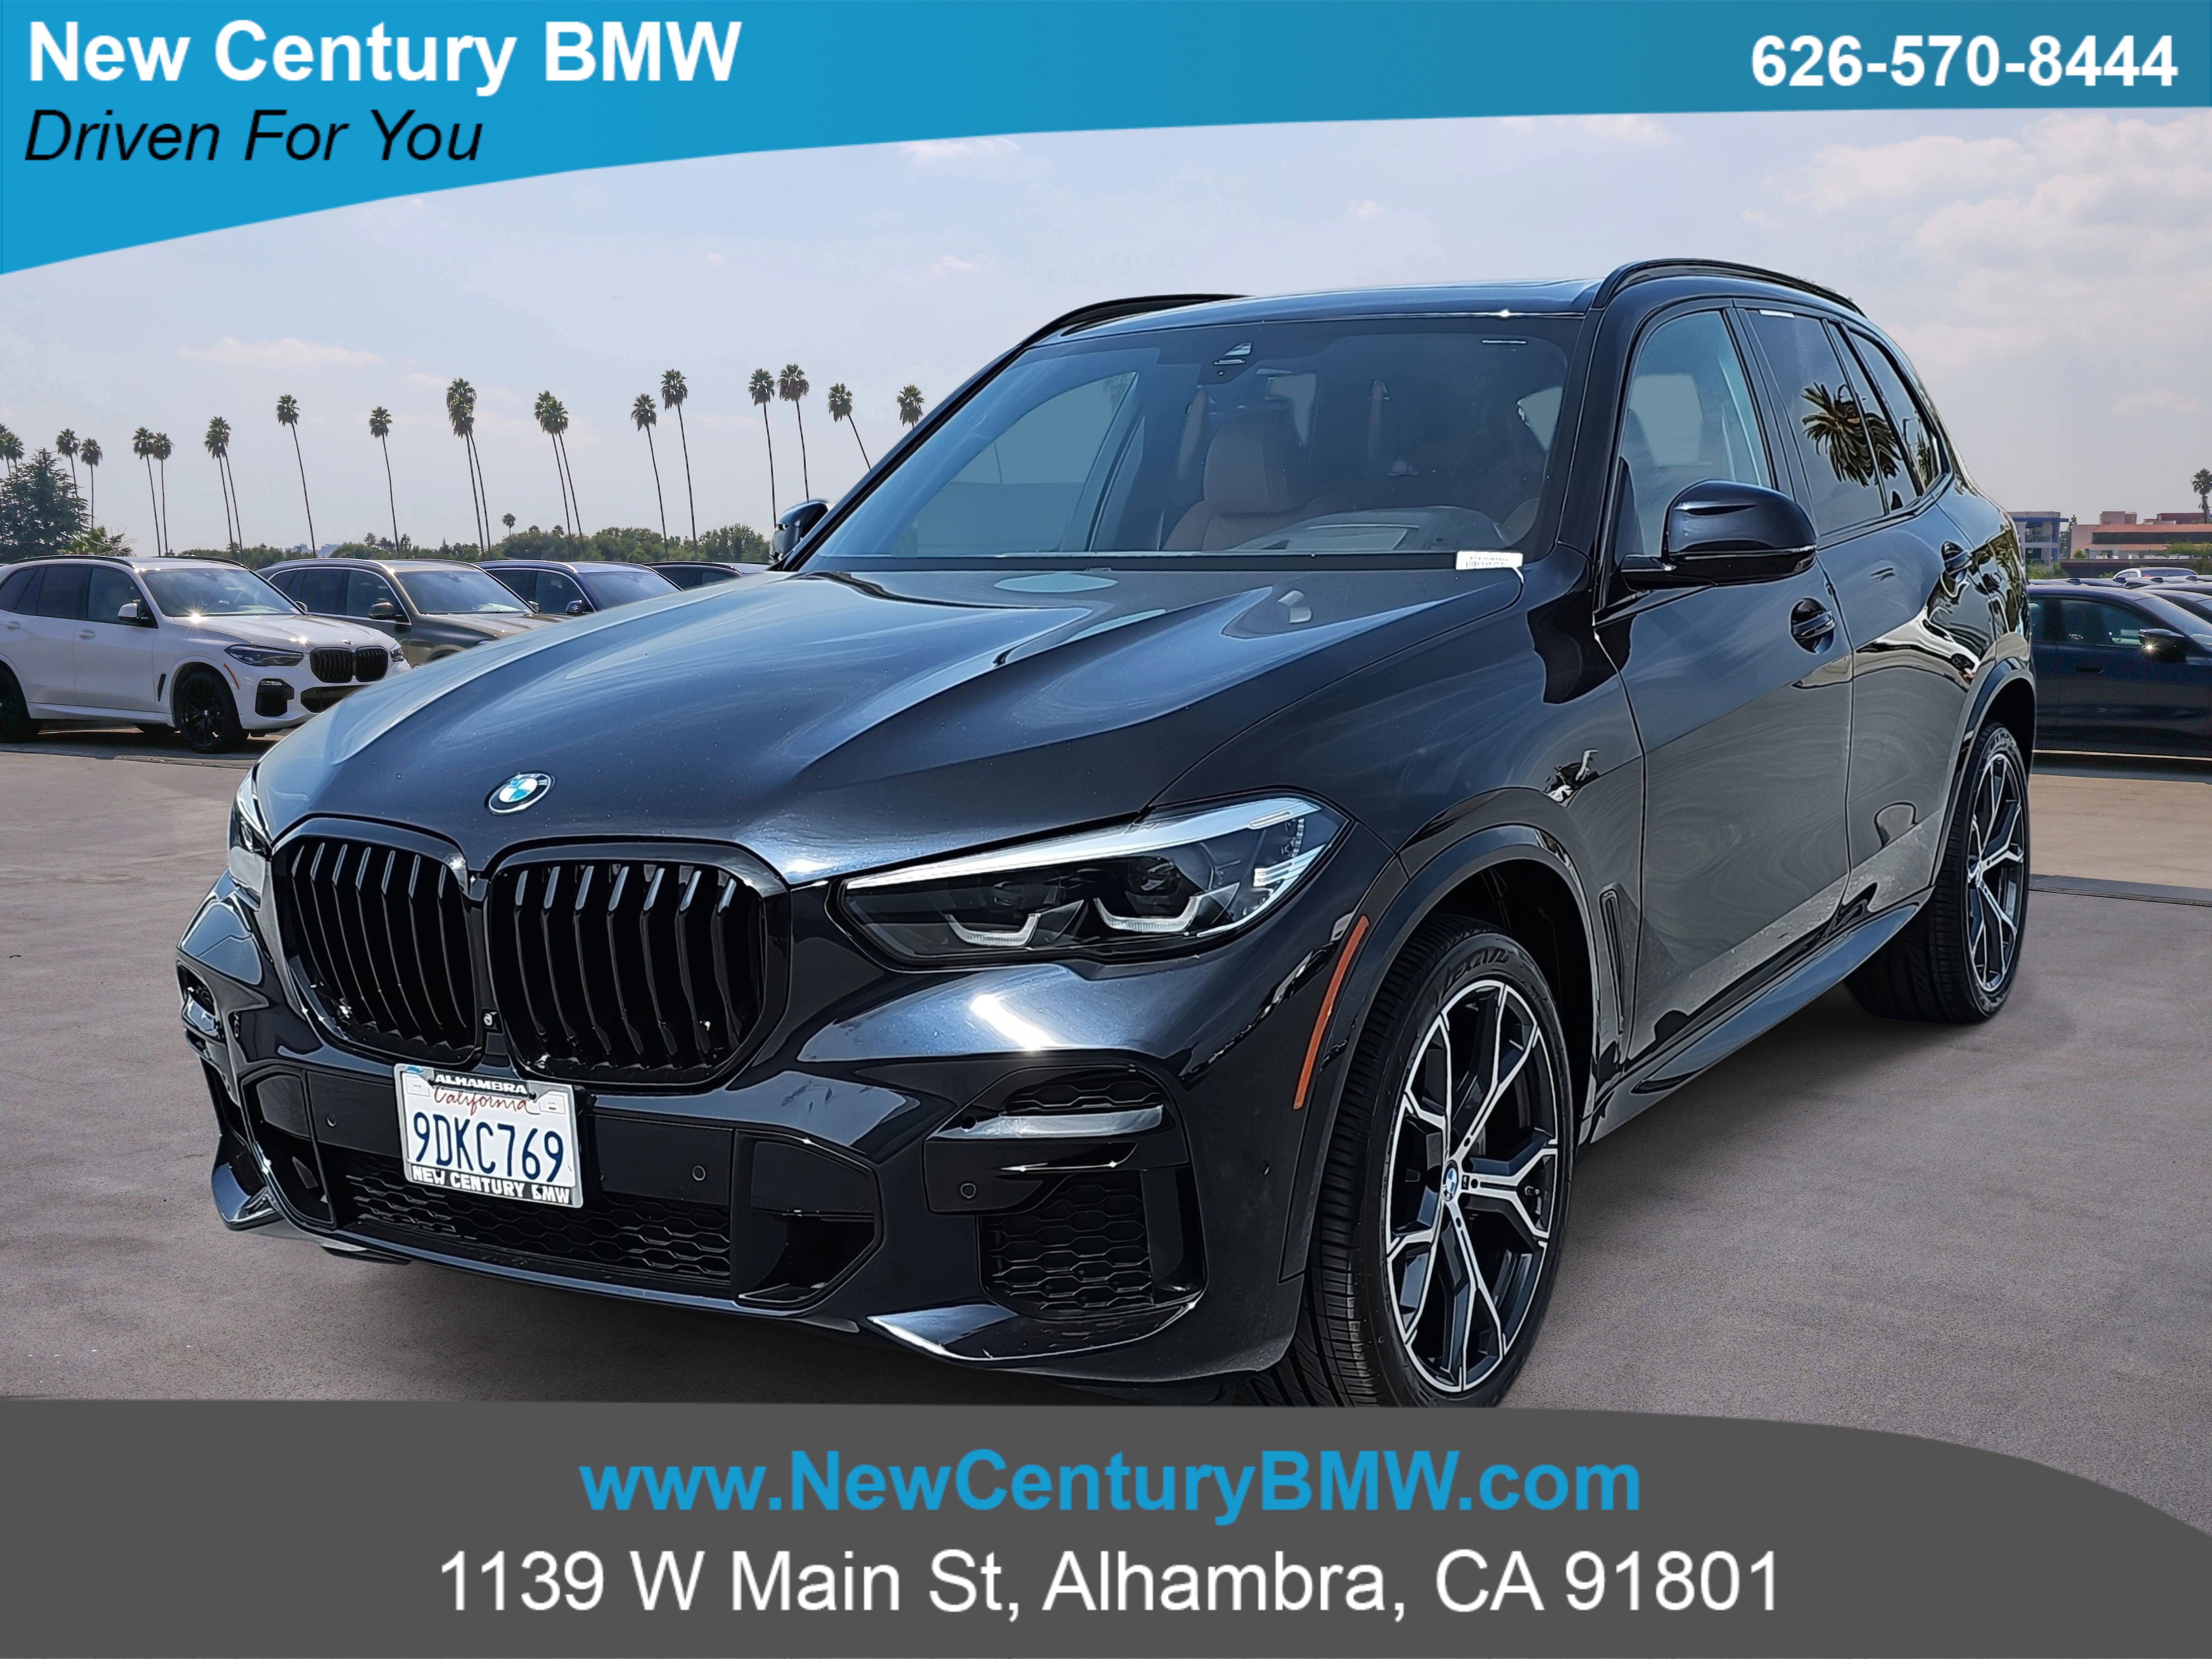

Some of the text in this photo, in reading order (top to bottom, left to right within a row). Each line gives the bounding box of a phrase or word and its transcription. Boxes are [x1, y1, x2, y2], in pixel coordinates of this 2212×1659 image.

[434, 1074, 528, 1094] ALHAMBRA
[434, 1086, 541, 1116] California
[413, 1111, 564, 1182] 9DKC769
[412, 1165, 570, 1205] NEW CENTURY BMW
